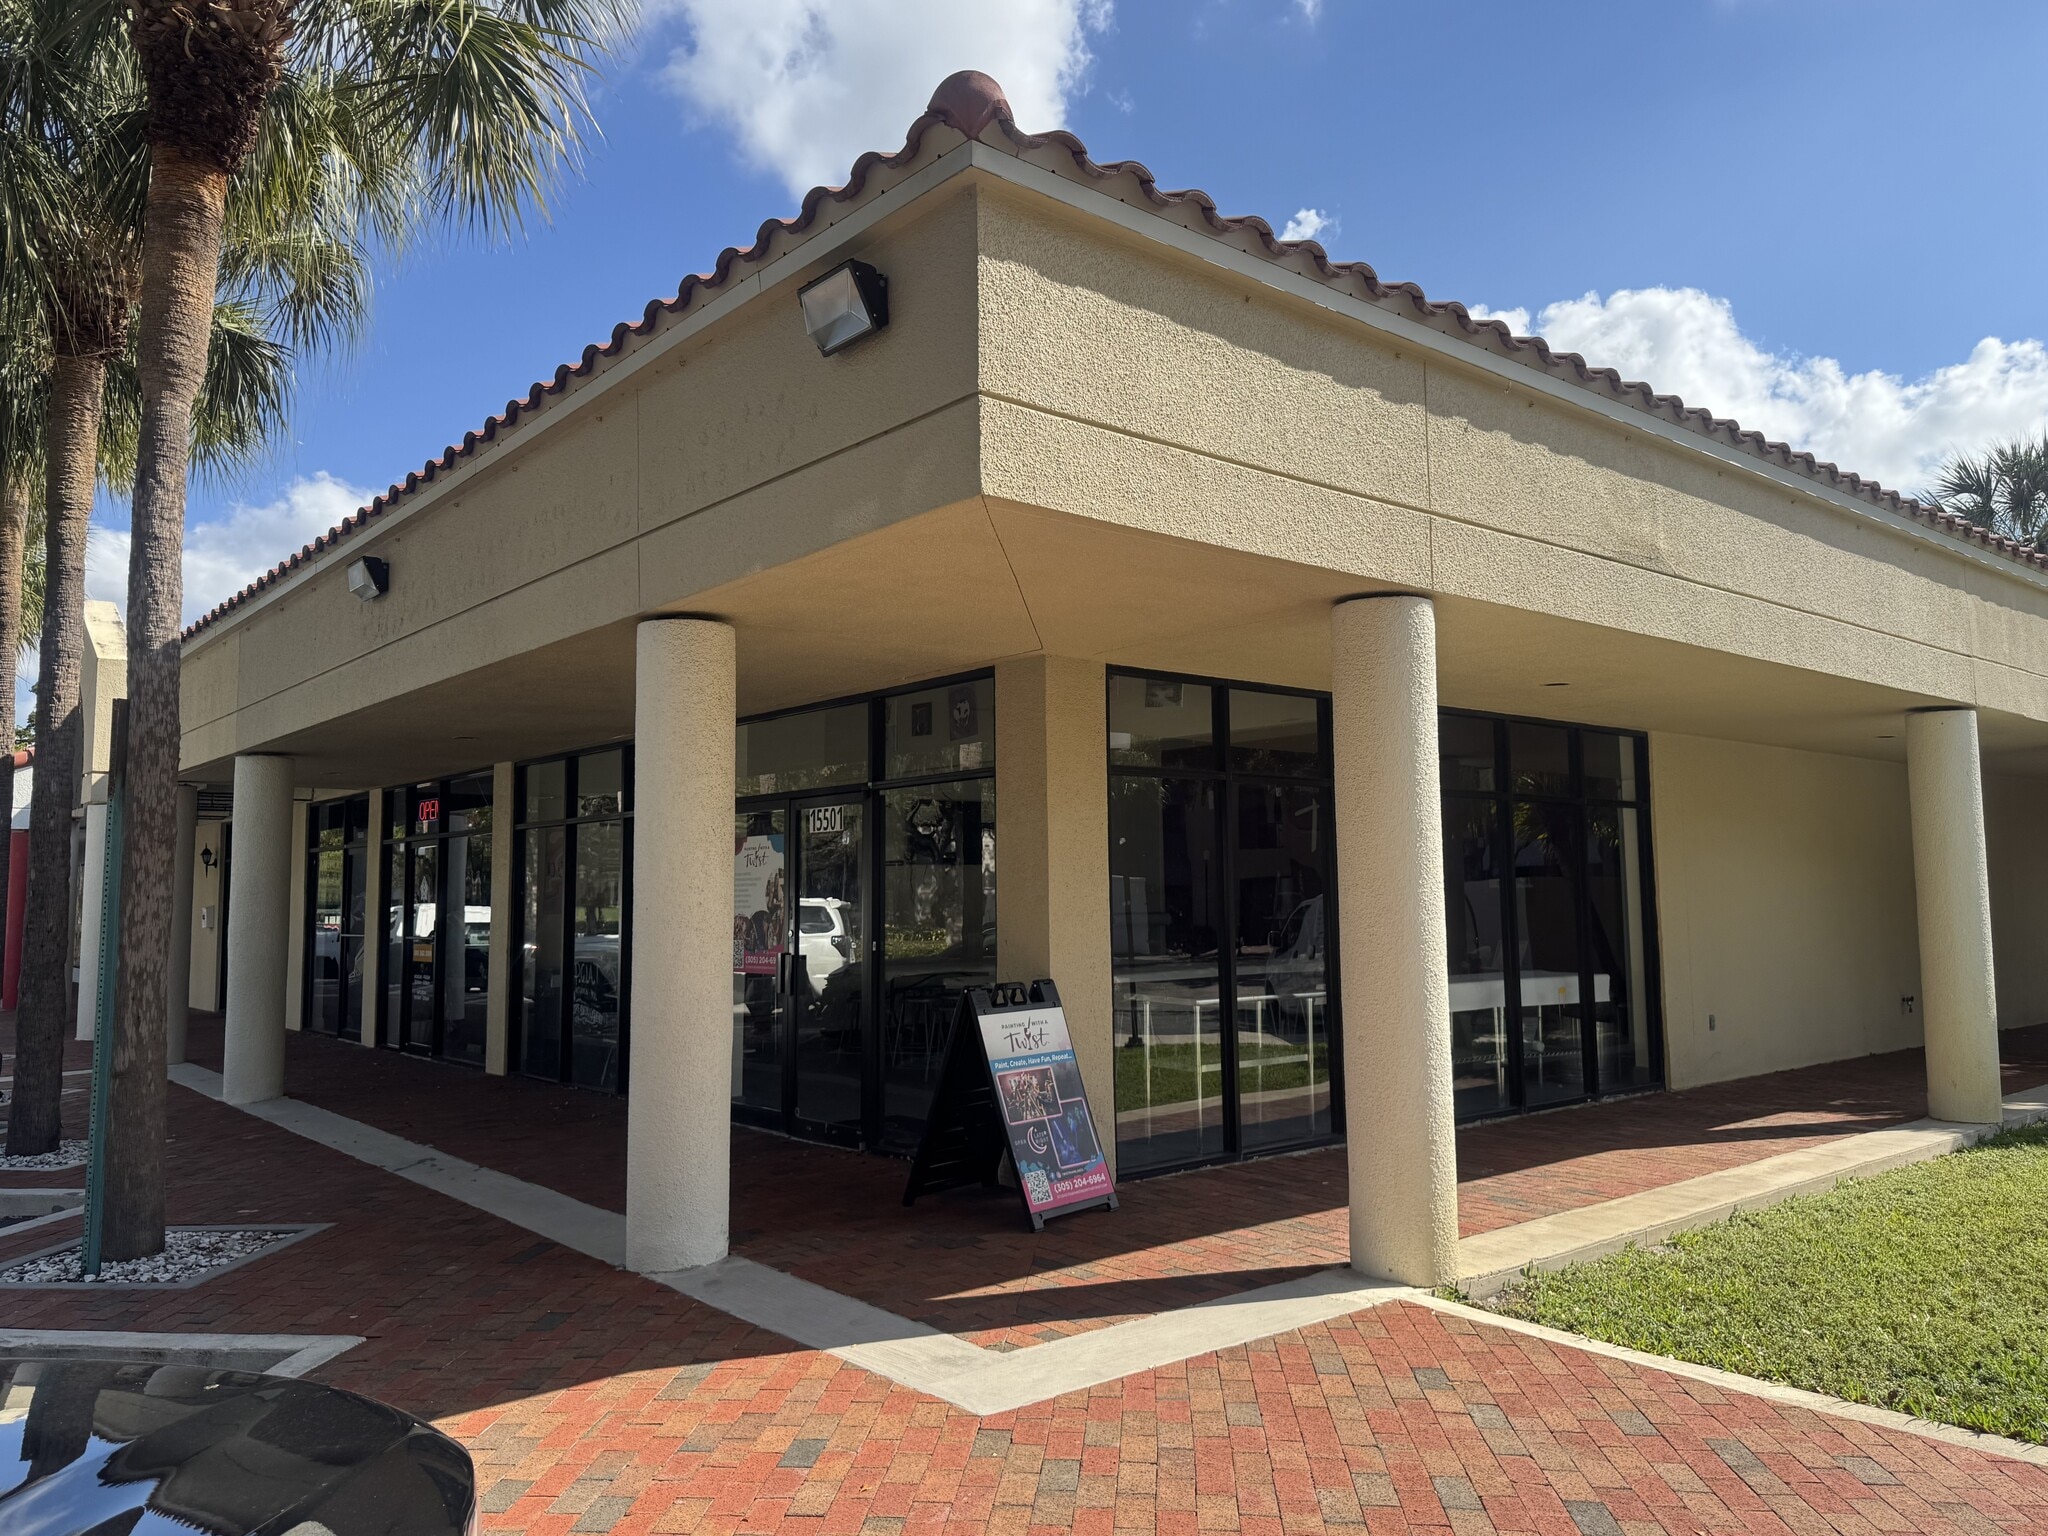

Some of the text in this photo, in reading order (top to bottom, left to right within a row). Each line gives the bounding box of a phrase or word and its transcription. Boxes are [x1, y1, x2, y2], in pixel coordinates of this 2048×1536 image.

[810, 806, 843, 832] 15501
[759, 955, 776, 965] 204-69
[1003, 1027, 1050, 1053] Twist
[1009, 1059, 1028, 1067] Create,
[1040, 1055, 1051, 1063] Fun,
[1054, 1181, 1073, 1193] (305)
[1073, 1173, 1106, 1187] 204-6964
